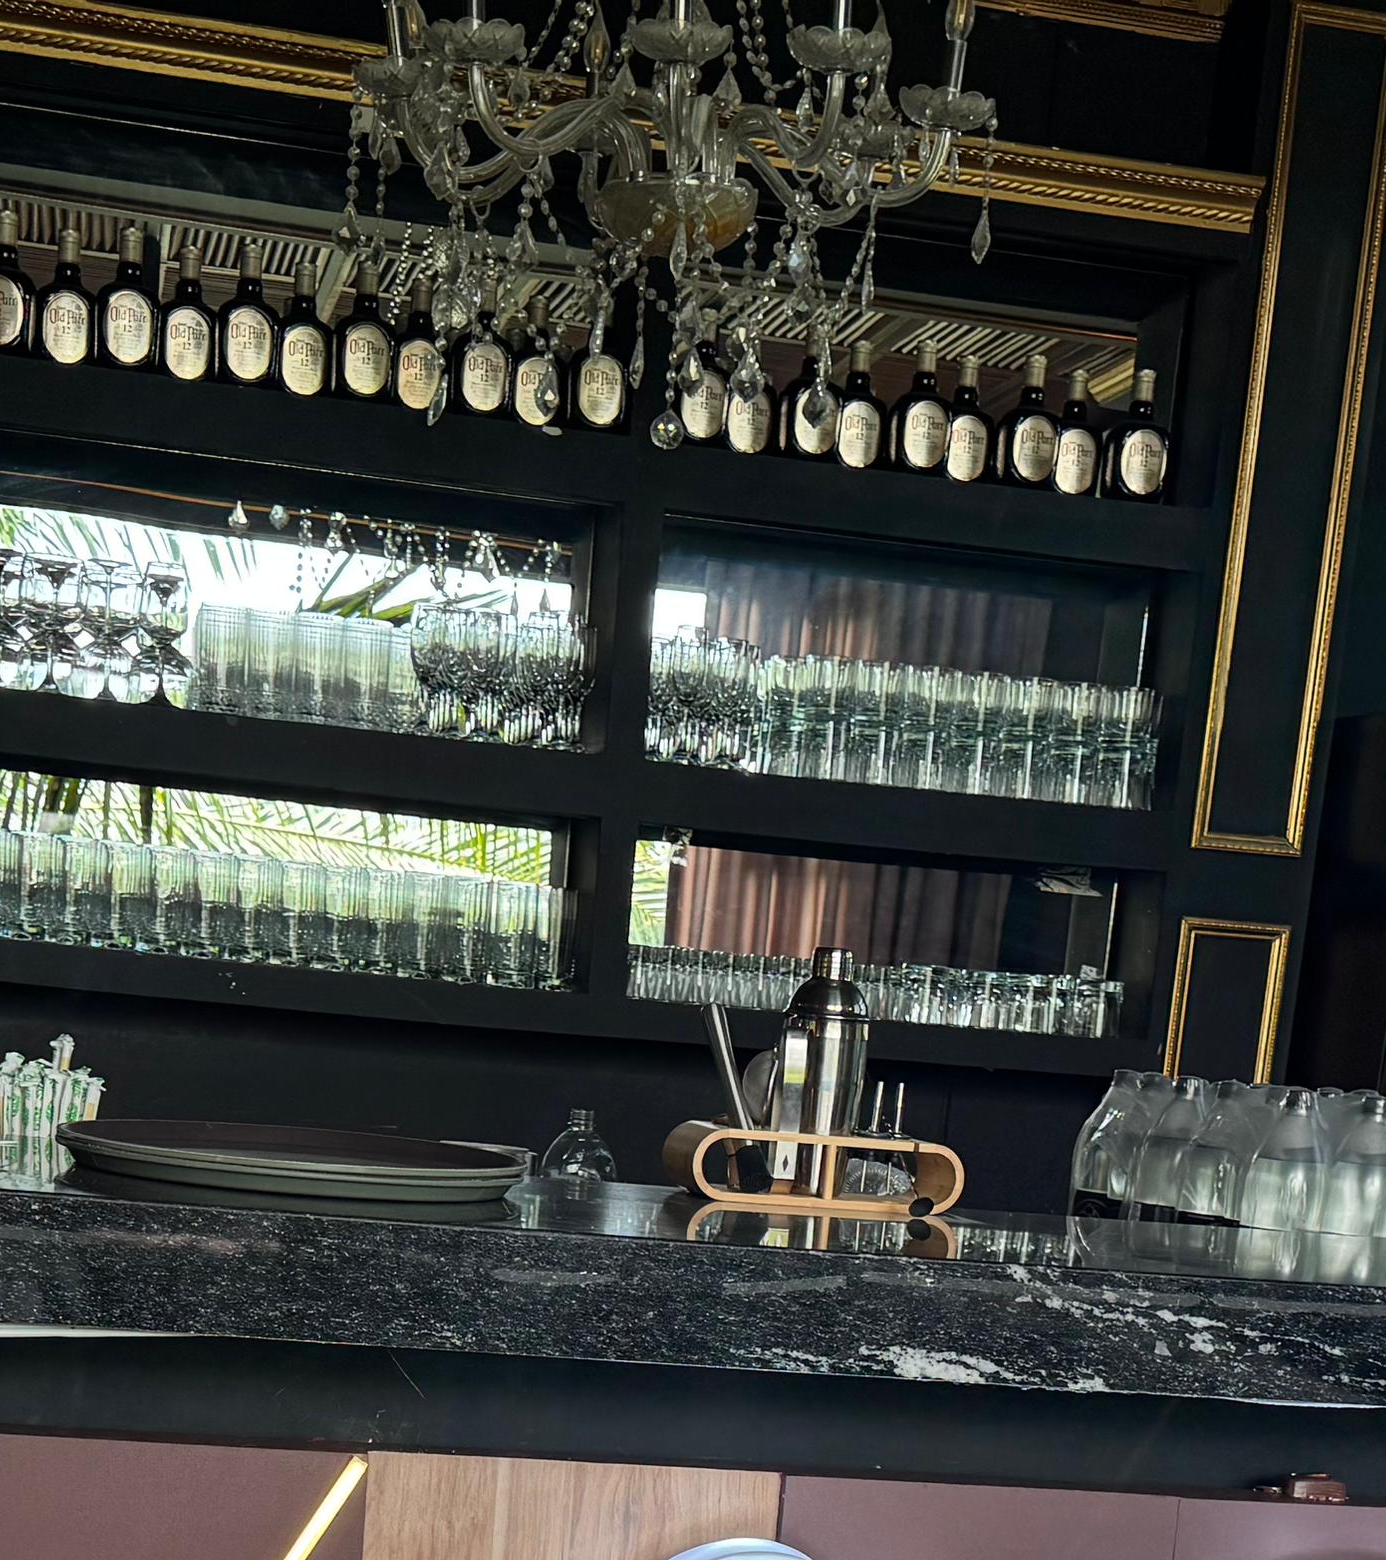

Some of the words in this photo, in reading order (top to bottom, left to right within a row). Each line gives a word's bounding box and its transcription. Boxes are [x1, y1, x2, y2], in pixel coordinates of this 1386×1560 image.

[49, 308, 65, 324] Old
[67, 310, 85, 325] Parr
[111, 306, 126, 322] Old
[128, 308, 147, 323] Parr
[61, 326, 70, 334] 12
[123, 324, 132, 333] 12
[171, 324, 186, 340] Old
[187, 326, 206, 341] Parr
[231, 324, 246, 339] Old
[248, 326, 266, 340] Parr
[183, 342, 191, 350] 12
[243, 342, 252, 350] 12
[289, 340, 303, 356] Old
[349, 339, 365, 354] Old
[367, 340, 385, 356] Parr
[301, 358, 309, 366] 12
[361, 357, 370, 365] 12
[480, 374, 489, 382] 12
